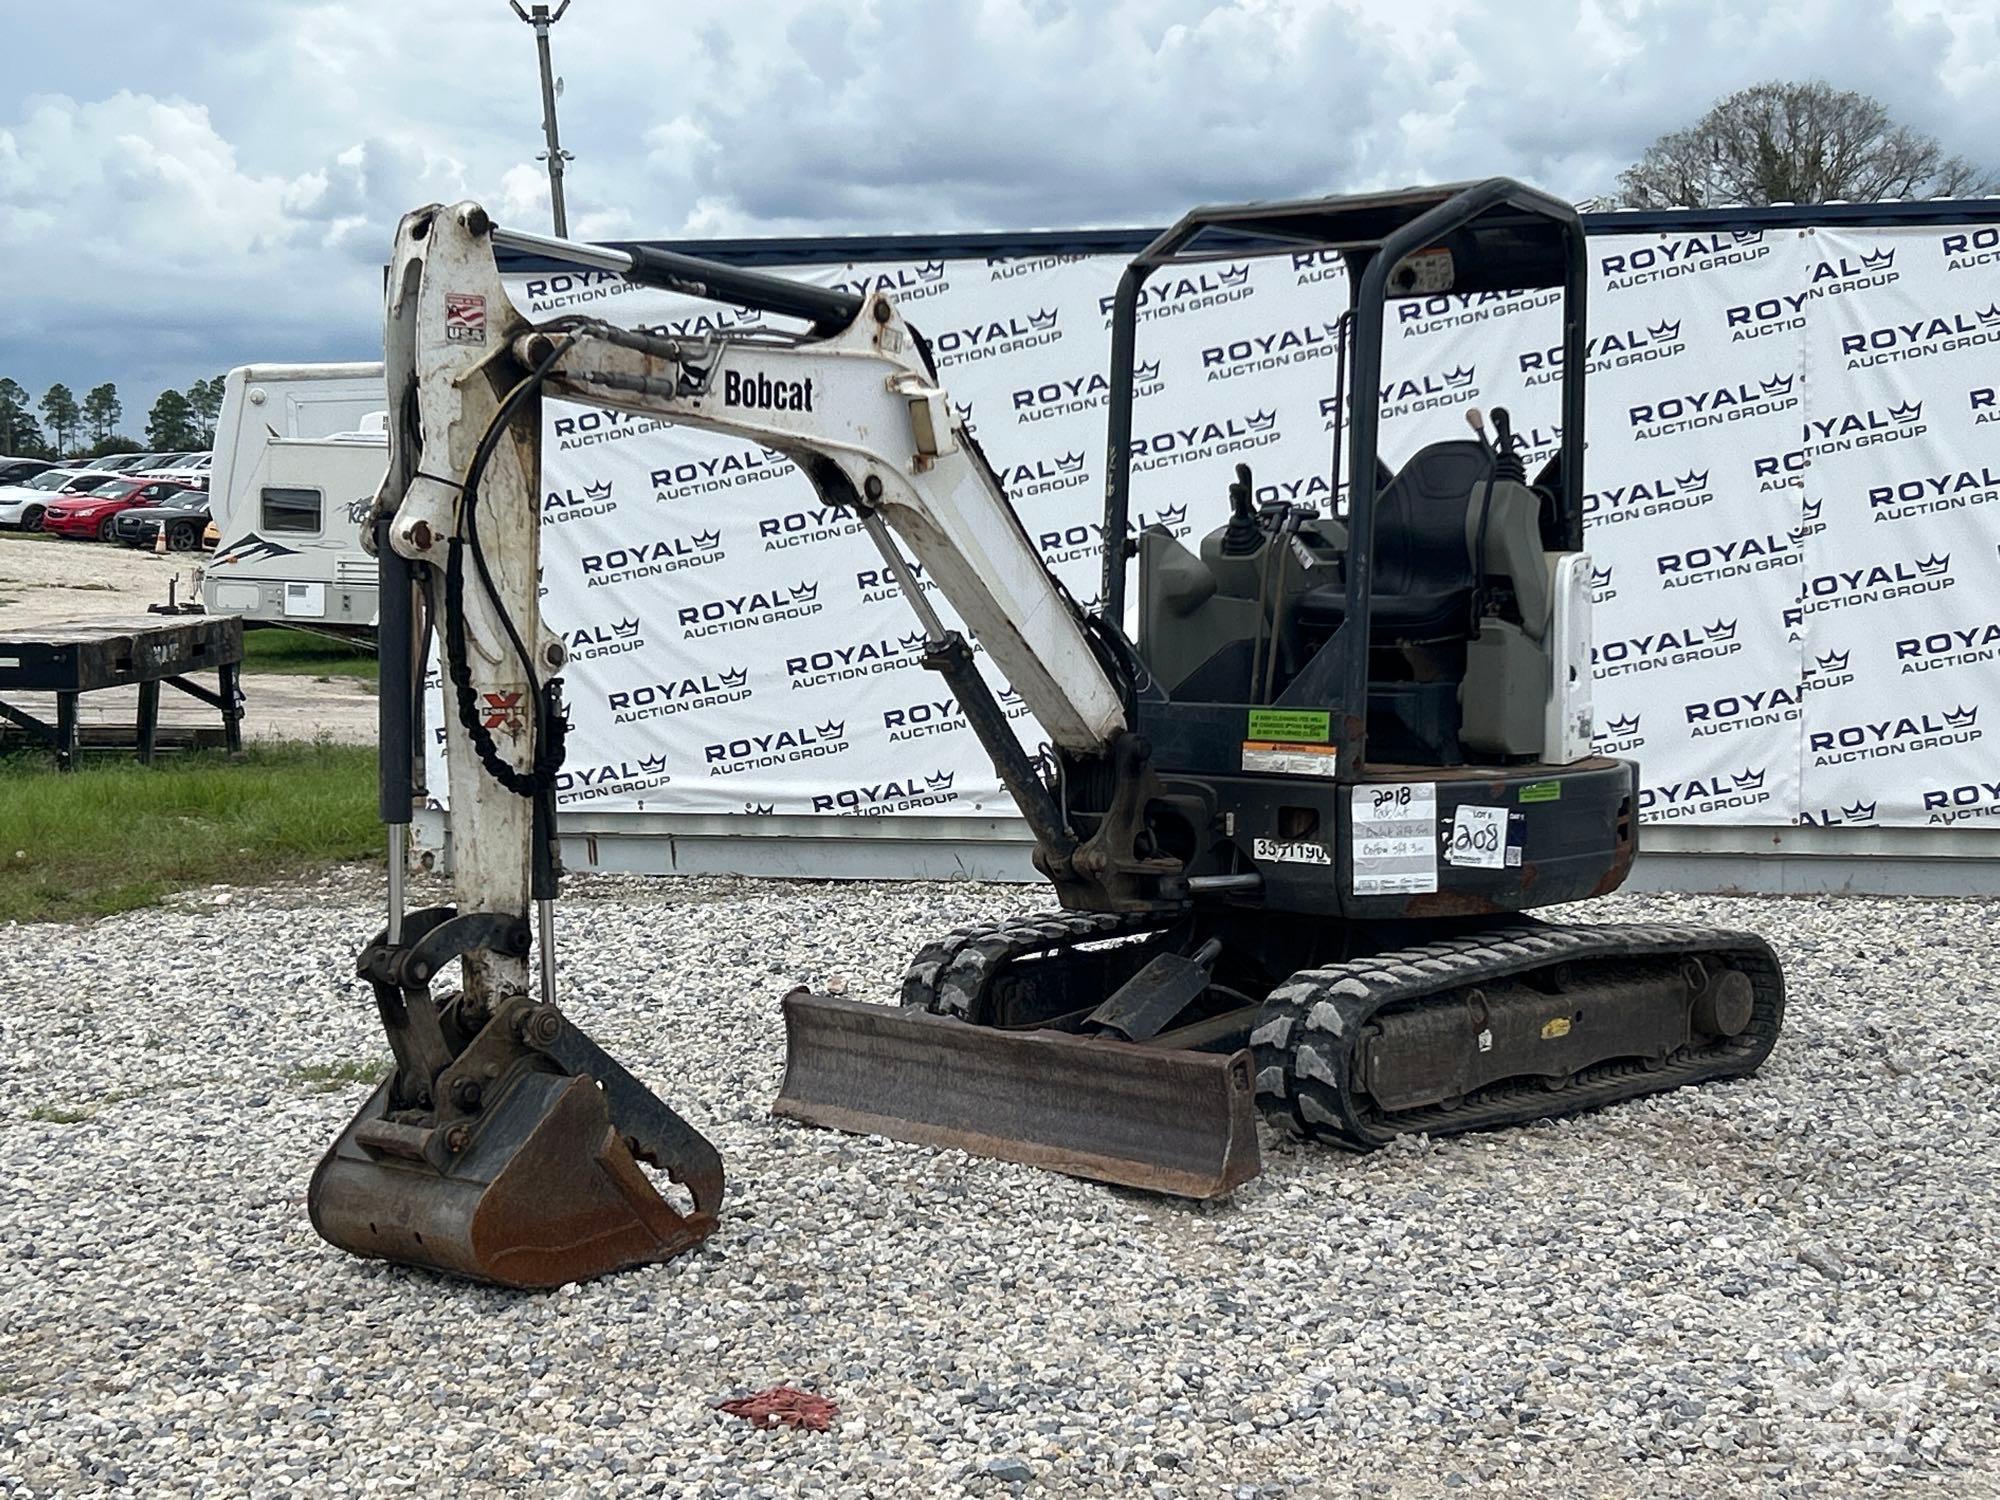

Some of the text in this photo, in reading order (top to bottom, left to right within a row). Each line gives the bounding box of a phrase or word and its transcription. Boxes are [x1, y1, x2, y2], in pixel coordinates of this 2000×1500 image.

[1601, 233, 1732, 277] ROYAL
[1606, 246, 1770, 292] AUCTION GROUP
[1948, 250, 2000, 272] AUCT
[526, 270, 618, 298] ROYA
[1297, 265, 1346, 287] AUCT
[1828, 272, 1900, 296] GROUP
[532, 288, 607, 313] AUCTION
[1104, 287, 1254, 330] ACTION GROUP
[1403, 292, 1561, 339] AUCTION GROUP
[1726, 291, 1808, 328] ROY
[650, 311, 735, 337] OYAL
[1732, 317, 1806, 343] AUCTIO
[1842, 314, 1977, 355] ROYAL
[934, 331, 1063, 369] UCTION GROUP
[1202, 325, 1325, 368] ROYAL
[1847, 331, 2000, 370] AUCTION GROU
[1207, 355, 1290, 382] AUCTION
[1524, 342, 1685, 388] AUCON GROUP
[725, 370, 813, 412] Bobcat
[1012, 373, 1110, 411] ROYA
[1319, 375, 1443, 417] RYAL
[1412, 388, 1480, 412] GROUP
[1630, 384, 1760, 427] ROYAL
[1017, 400, 1093, 424] AUCTION
[1634, 398, 1798, 442] AUCTION GROUP
[1804, 410, 1890, 443] YAL
[559, 427, 635, 451] AUCTION
[1130, 419, 1246, 458] ROYAL
[1131, 431, 1281, 473] AUCTION GROUP
[1804, 425, 1928, 458] TION GROUP
[651, 451, 763, 488] ROYAL
[656, 464, 796, 502] AUCTION GROUP
[1027, 474, 1089, 497] GROUP
[557, 502, 617, 523] GROUP
[1583, 480, 1677, 514] OYAL
[1583, 493, 1713, 529] CTION GROUP
[1874, 497, 1966, 523] AUCTION
[759, 506, 853, 537] ROYA
[582, 538, 693, 574] ROYAL
[764, 527, 841, 552] AUCTION
[1657, 535, 1788, 575] ROYAL
[587, 551, 725, 588] AUCTION GROUP
[1662, 553, 1803, 590] AUCTION GRO
[677, 590, 790, 626] ROYAL
[1803, 578, 1955, 615] UCTION GROUP
[683, 603, 823, 640] AUCTION GROUP
[585, 639, 645, 660] GROUP
[786, 640, 900, 676] ROYAL
[1896, 624, 2000, 660] ROYA
[791, 655, 926, 690] AUCTION GROU
[1593, 643, 1742, 680] UCTION GROUP
[1901, 650, 1993, 675] AUCTION
[608, 676, 720, 711] ROYAL
[1801, 674, 1854, 692] ROUP
[614, 689, 752, 724] AUCTION GROUP
[884, 699, 963, 729] ROY
[889, 719, 967, 743] AUCTION
[1691, 713, 1779, 738] AUCTION
[1810, 715, 1943, 752] ROYAL
[705, 729, 816, 763] ROYAL
[710, 742, 849, 776] AUCTION GROUP
[1591, 737, 1645, 755] ROUP
[1814, 730, 1982, 767] AUCTION GROUP
[555, 762, 639, 792] OYAL
[557, 776, 671, 805] CTION GROUP
[1639, 776, 1732, 808] OYAL
[811, 779, 925, 813] ROYAL
[896, 792, 958, 812] GROUP
[1370, 786, 1412, 807] 2018
[1639, 792, 1770, 823] CTION GROUP
[1923, 783, 2000, 811] ROY
[1455, 823, 1498, 852] 208
